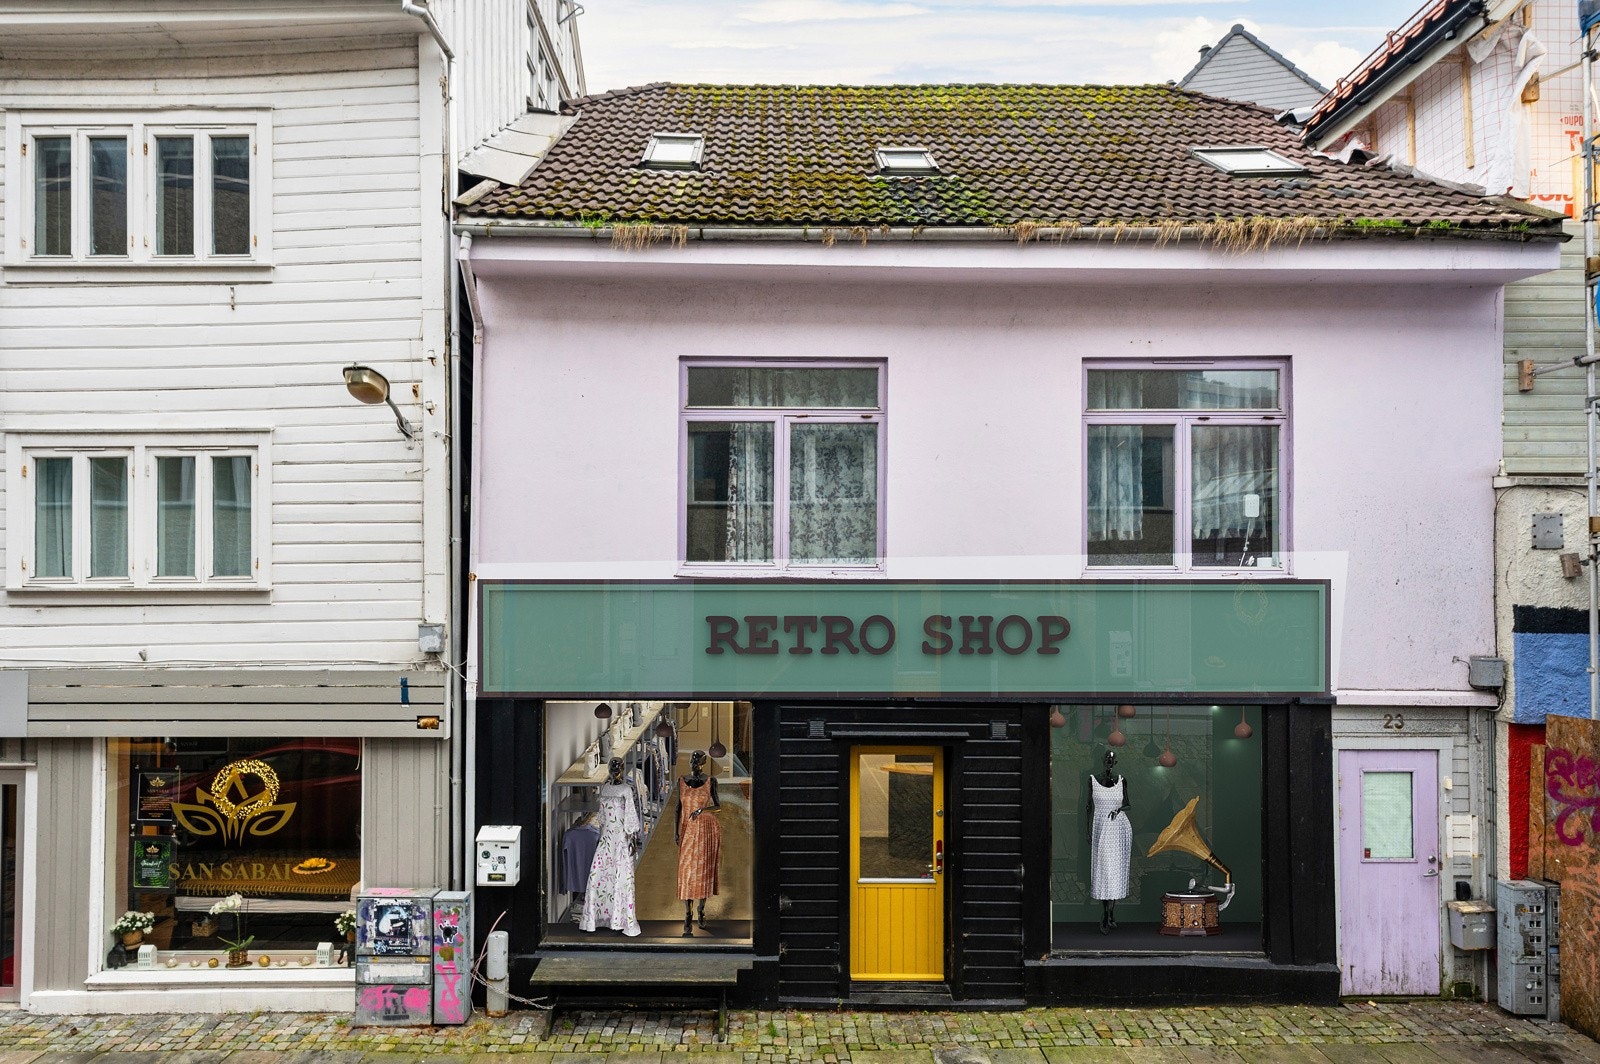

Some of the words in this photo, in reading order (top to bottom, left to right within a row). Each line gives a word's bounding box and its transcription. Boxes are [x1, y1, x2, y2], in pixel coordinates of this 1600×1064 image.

[705, 614, 896, 655] RETRO
[922, 614, 1071, 655] SHOP
[1383, 713, 1404, 729] 23
[168, 862, 215, 880] SAN
[221, 862, 291, 880] SABAI
[186, 886, 214, 896] THAI
